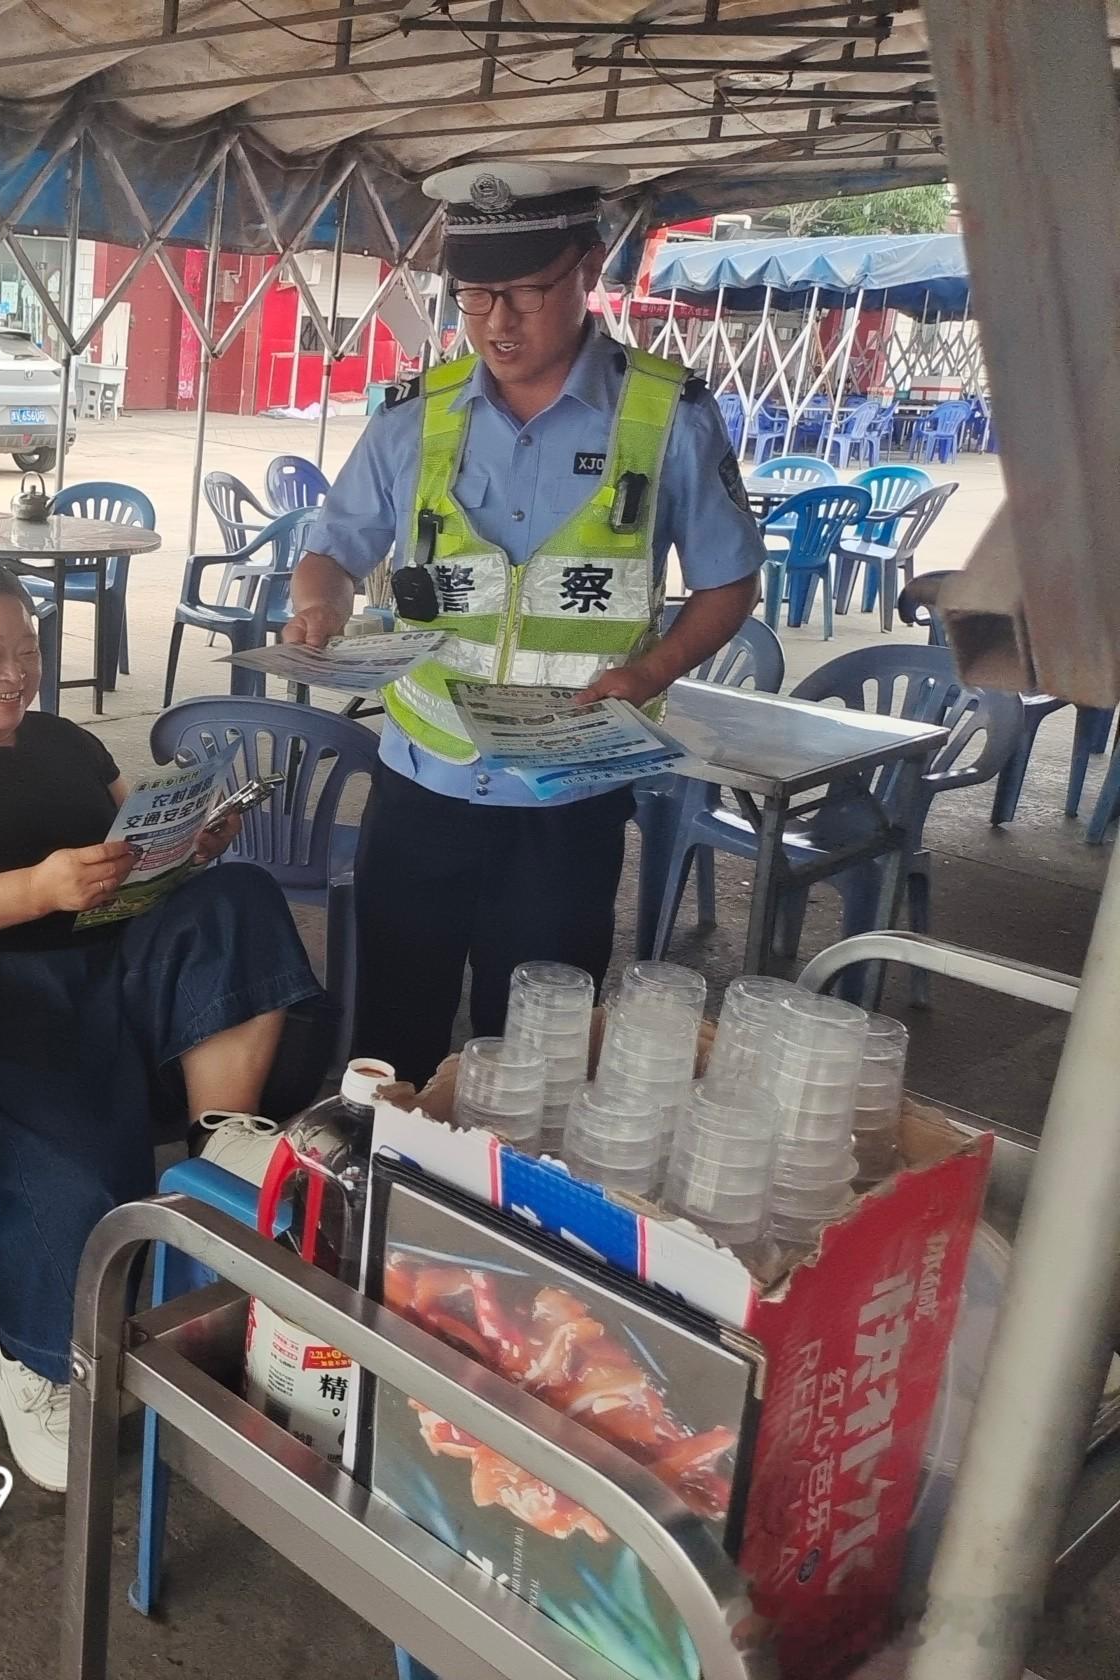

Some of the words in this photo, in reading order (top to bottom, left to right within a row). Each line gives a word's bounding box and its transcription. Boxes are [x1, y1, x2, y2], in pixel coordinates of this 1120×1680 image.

[318, 1374, 348, 1401] 精
[805, 1366, 848, 1542] 红心芭乐
